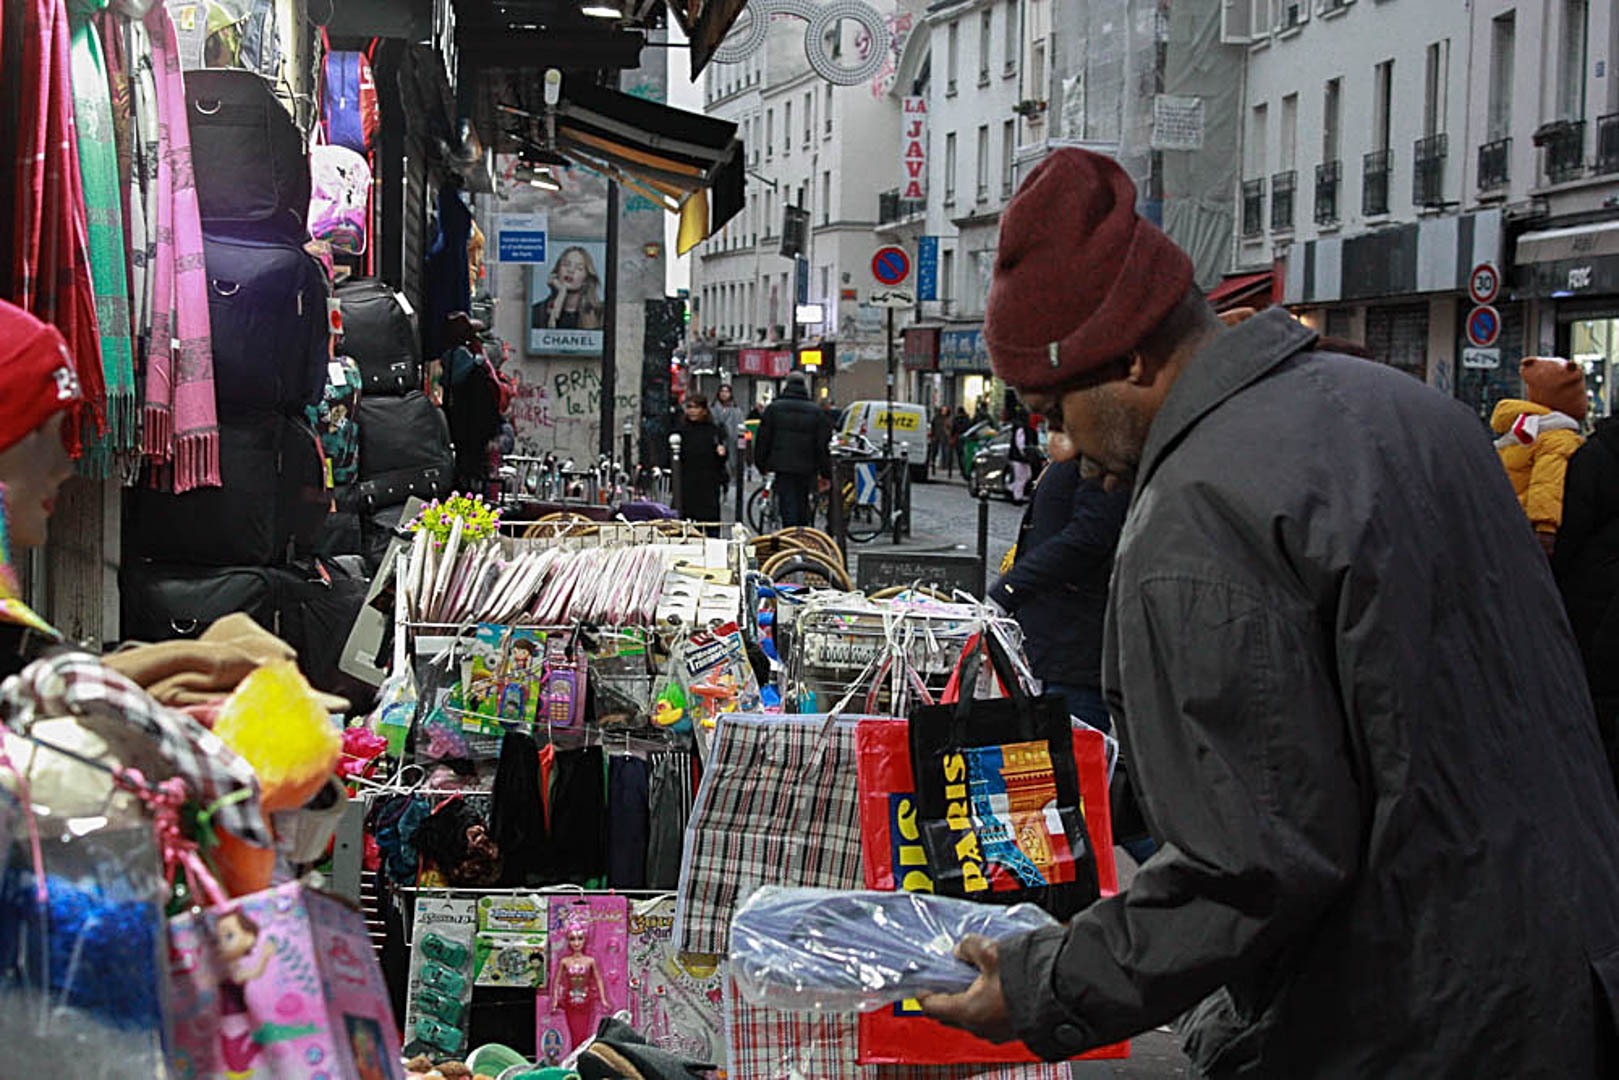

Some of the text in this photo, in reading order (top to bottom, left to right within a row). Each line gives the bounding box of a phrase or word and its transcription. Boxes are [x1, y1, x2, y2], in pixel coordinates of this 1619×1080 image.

[904, 99, 927, 114] LA
[904, 120, 925, 198] JAVA
[1475, 275, 1493, 291] 30
[542, 335, 596, 346] CHANEL
[566, 396, 584, 415] le
[878, 413, 914, 428] Hrtz
[942, 752, 990, 894] PARIS
